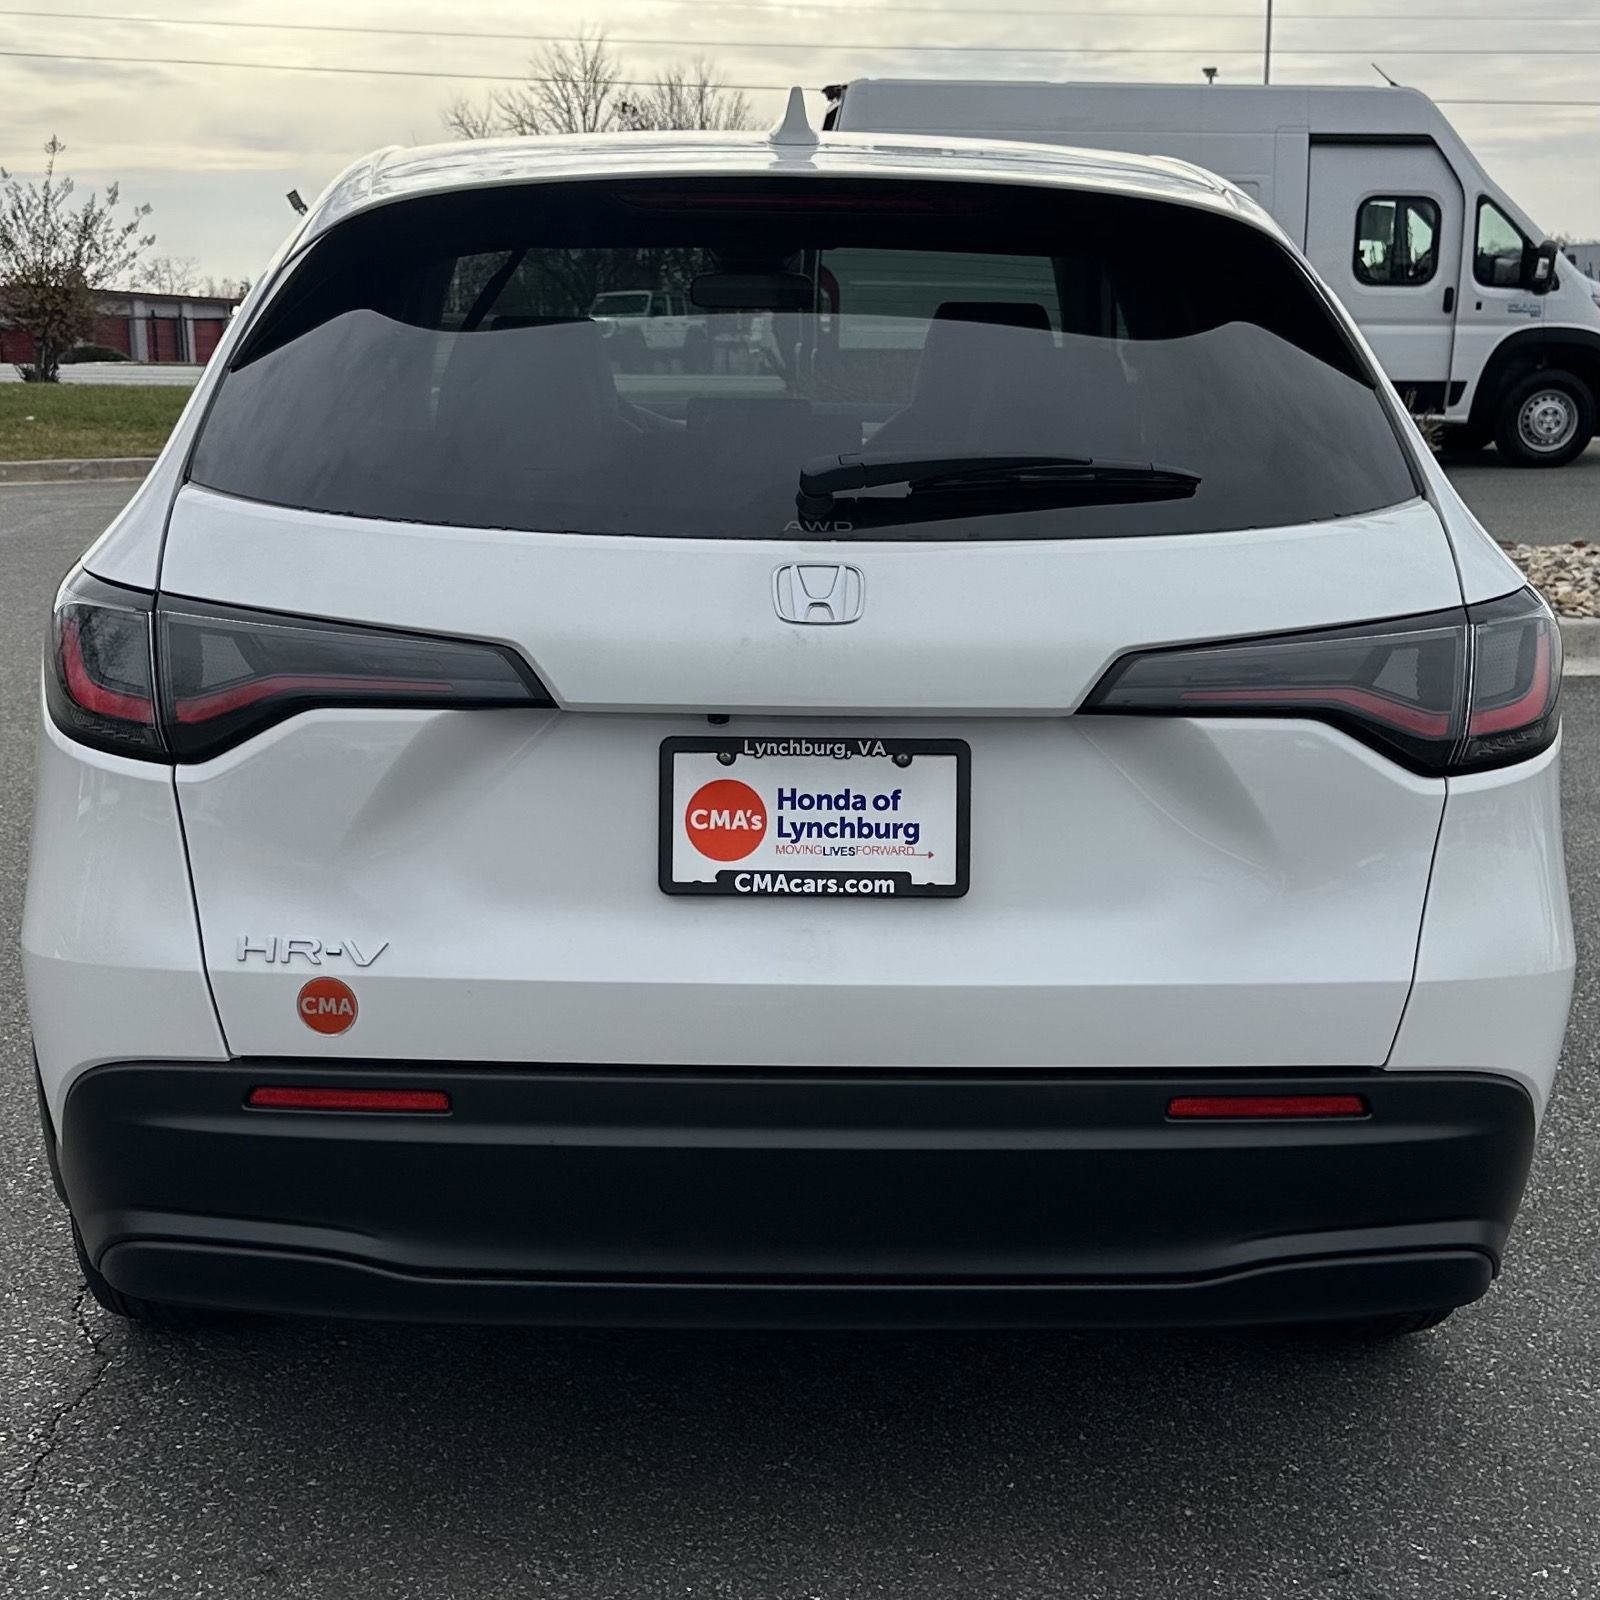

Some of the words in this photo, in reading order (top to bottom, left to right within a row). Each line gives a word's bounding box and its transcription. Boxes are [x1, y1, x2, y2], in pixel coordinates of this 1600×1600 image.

[783, 520, 853, 532] AWD
[743, 739, 853, 758] Lynchburg,
[858, 740, 887, 756] VA
[777, 788, 866, 811] Honda
[872, 789, 902, 811] of
[690, 809, 763, 831] CMA's
[777, 816, 920, 845] Lynchburg
[734, 873, 895, 894] CMAcars.com
[237, 935, 390, 968] HR-V
[301, 997, 353, 1015] CMA
